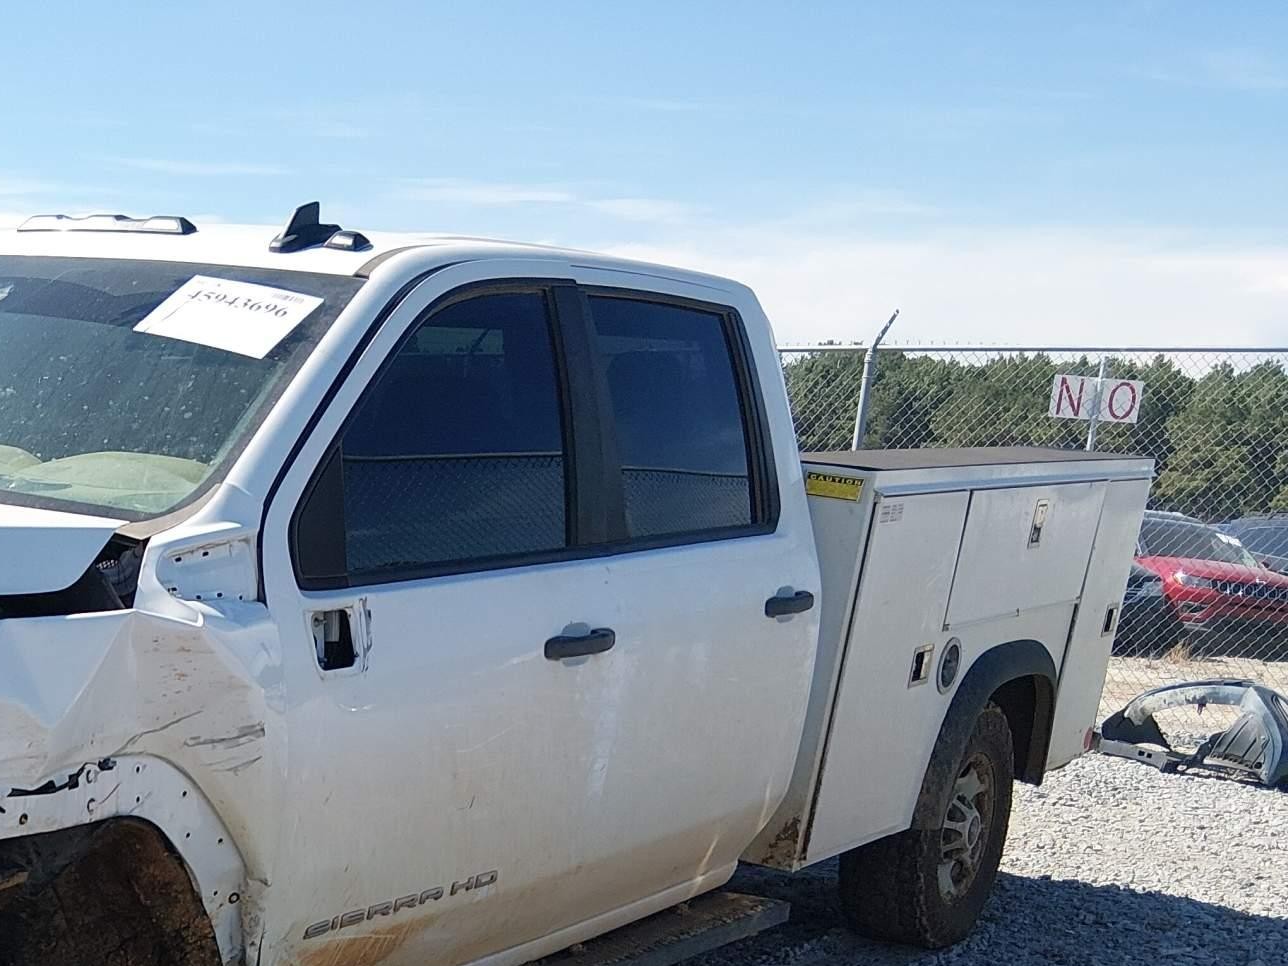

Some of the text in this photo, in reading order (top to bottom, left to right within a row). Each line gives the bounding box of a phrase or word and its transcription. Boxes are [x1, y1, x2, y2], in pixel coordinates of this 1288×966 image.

[187, 289, 288, 318] 45943696
[810, 474, 861, 486] CAUTION
[303, 869, 499, 941] SIERRA HD
